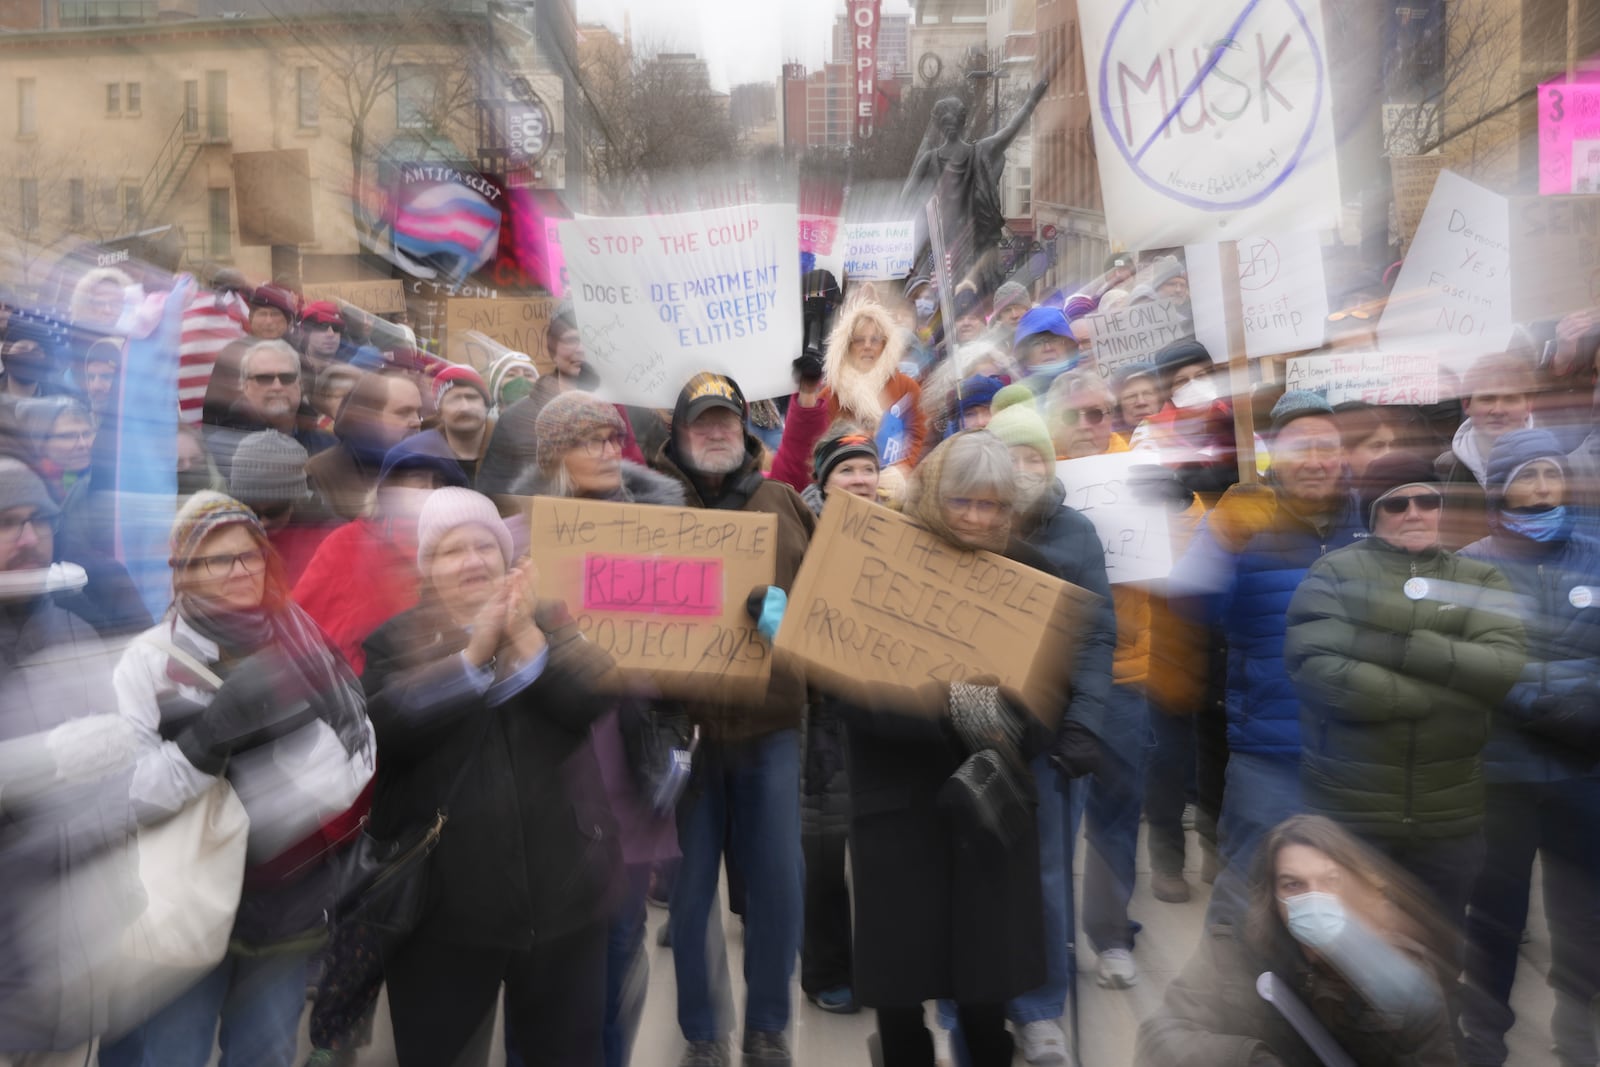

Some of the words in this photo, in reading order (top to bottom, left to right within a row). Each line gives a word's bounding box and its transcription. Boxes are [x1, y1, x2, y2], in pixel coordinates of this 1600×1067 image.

[854, 7, 874, 140] ORPHEU
[1117, 32, 1293, 147] MUSK
[510, 116, 523, 156] BLOCK
[522, 108, 543, 154] 100
[405, 167, 501, 200] ANTIFASCIST
[587, 235, 644, 255] STOP
[659, 232, 700, 255] THE
[707, 219, 759, 247] COUP
[650, 264, 779, 303] DEPARTMENT
[843, 260, 878, 274] MPEACH
[457, 307, 511, 330] SAVE
[659, 302, 684, 323] OF
[706, 290, 776, 321] GREEDY
[1089, 309, 1129, 336] THE
[1129, 300, 1173, 329] ONLY
[678, 314, 767, 347] ELITISTS
[1096, 323, 1179, 360] MINORITY
[553, 505, 597, 545] We
[668, 511, 768, 555] PEOPLE
[841, 503, 886, 547] WE
[950, 550, 1050, 616] PEOPLE
[588, 556, 720, 606] REJECT
[851, 556, 999, 641] REJECT
[703, 624, 766, 663] 2025
[803, 597, 928, 674] PROJECT
